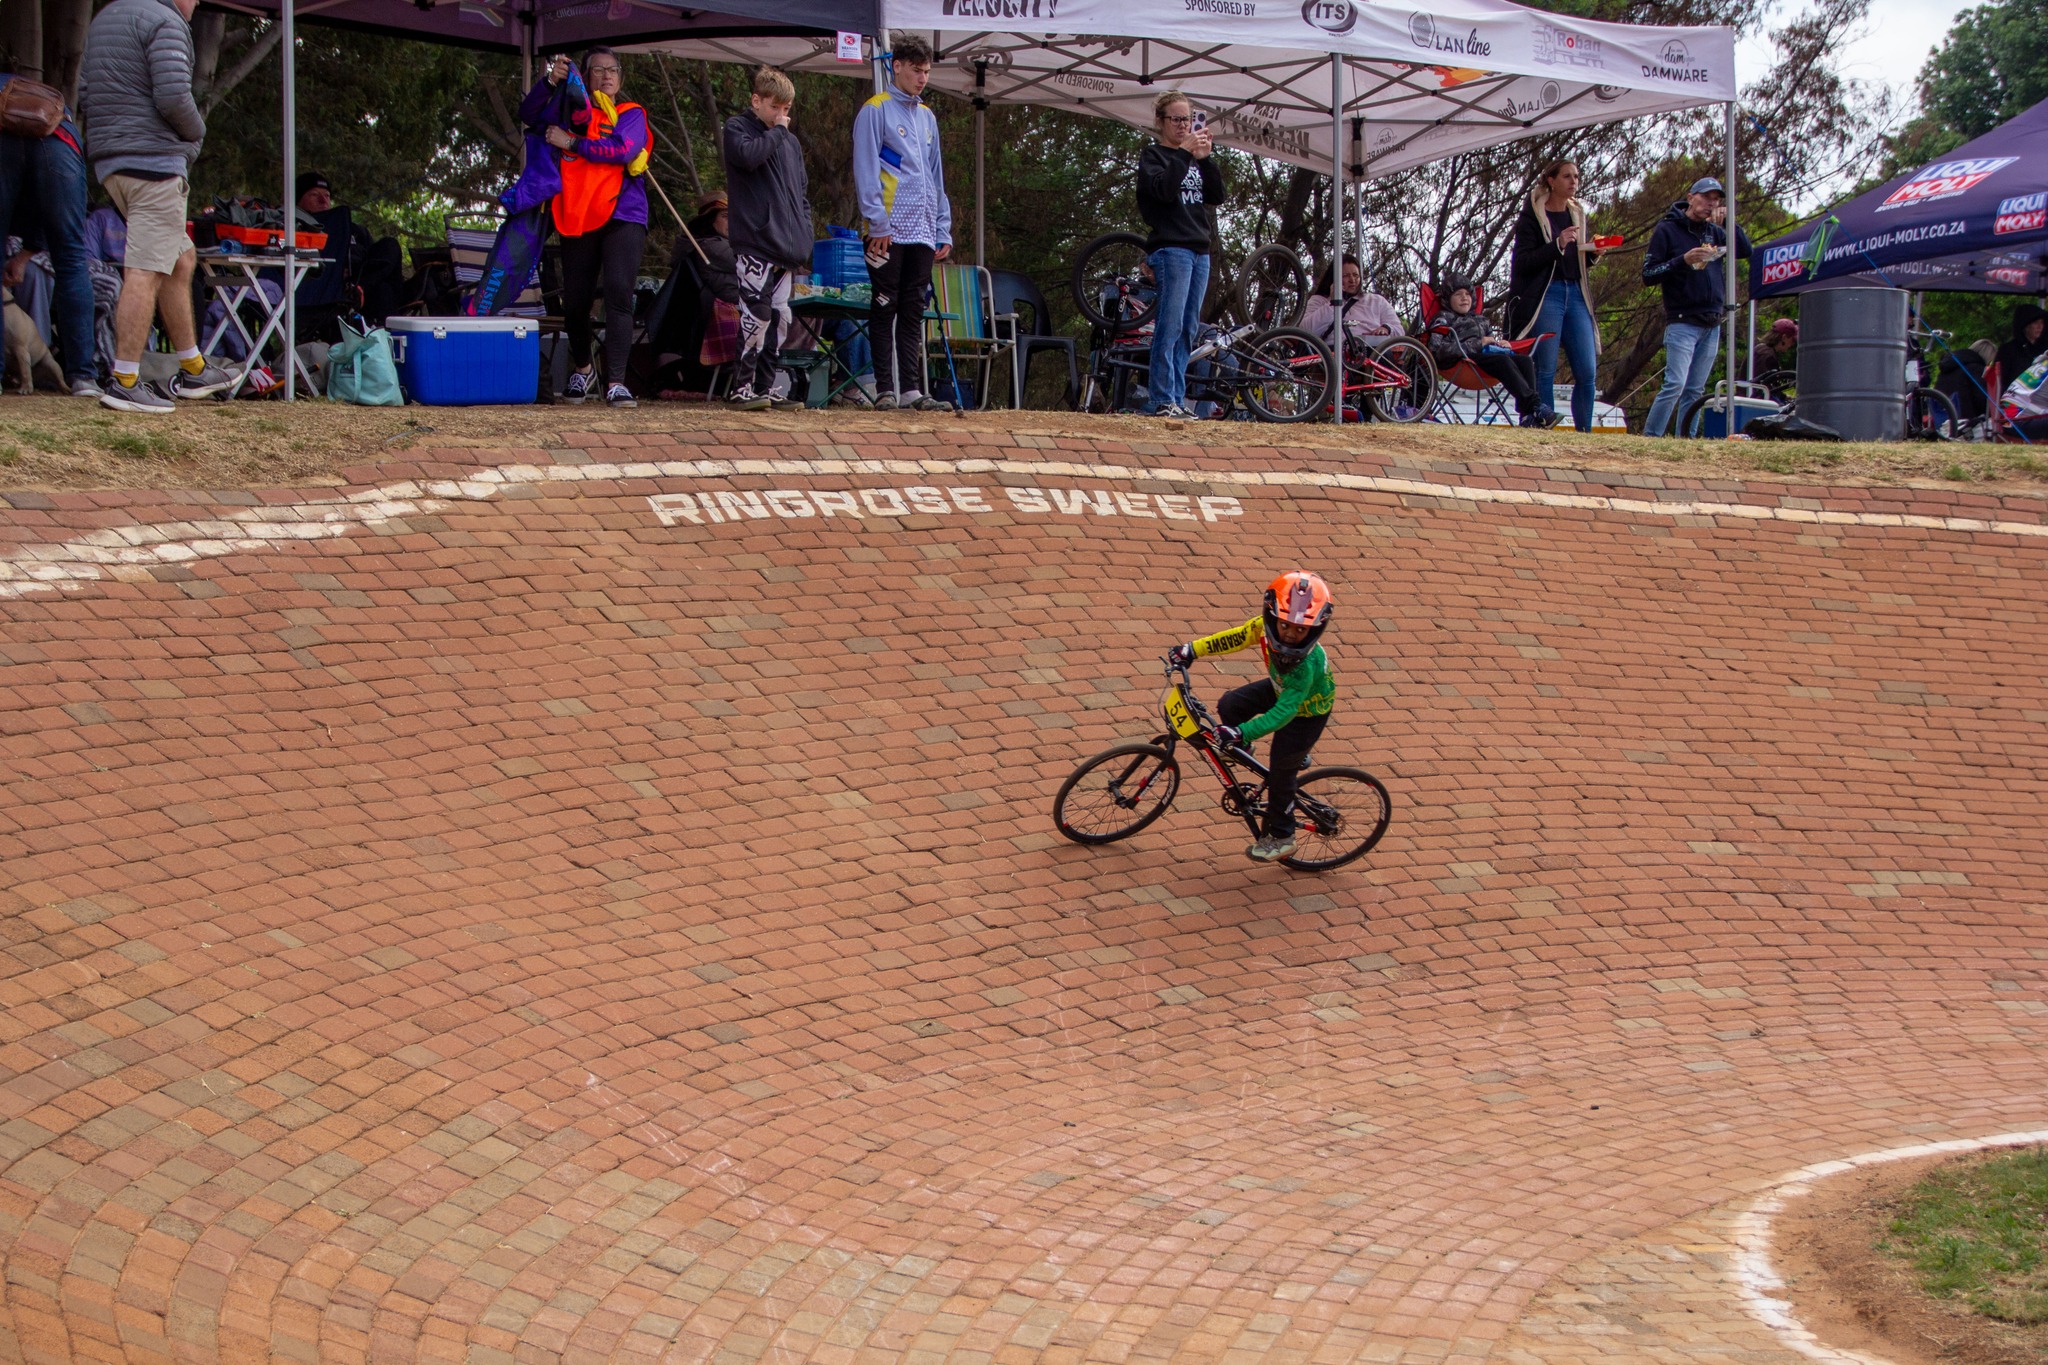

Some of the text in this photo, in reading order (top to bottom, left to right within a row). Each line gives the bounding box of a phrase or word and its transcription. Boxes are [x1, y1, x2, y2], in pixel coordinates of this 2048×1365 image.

[1185, 0, 1256, 17] SPONSORED BY
[1315, 3, 1346, 20] ITS
[1557, 31, 1601, 52] Roban
[1641, 65, 1709, 83] DAMWARE
[1910, 156, 2019, 182] LIQUI
[1888, 172, 1992, 203] MOLY
[2000, 194, 2047, 215] LIQUI
[1996, 211, 2046, 233] MOLY
[1824, 220, 1966, 261] WWW.LIQUI-MOLY.CO.ZA
[1765, 244, 1809, 264] LIQUI
[1764, 260, 1803, 282] MOLY
[646, 486, 1248, 527] RINGROSE SWEEP
[1169, 700, 1188, 728] 54
